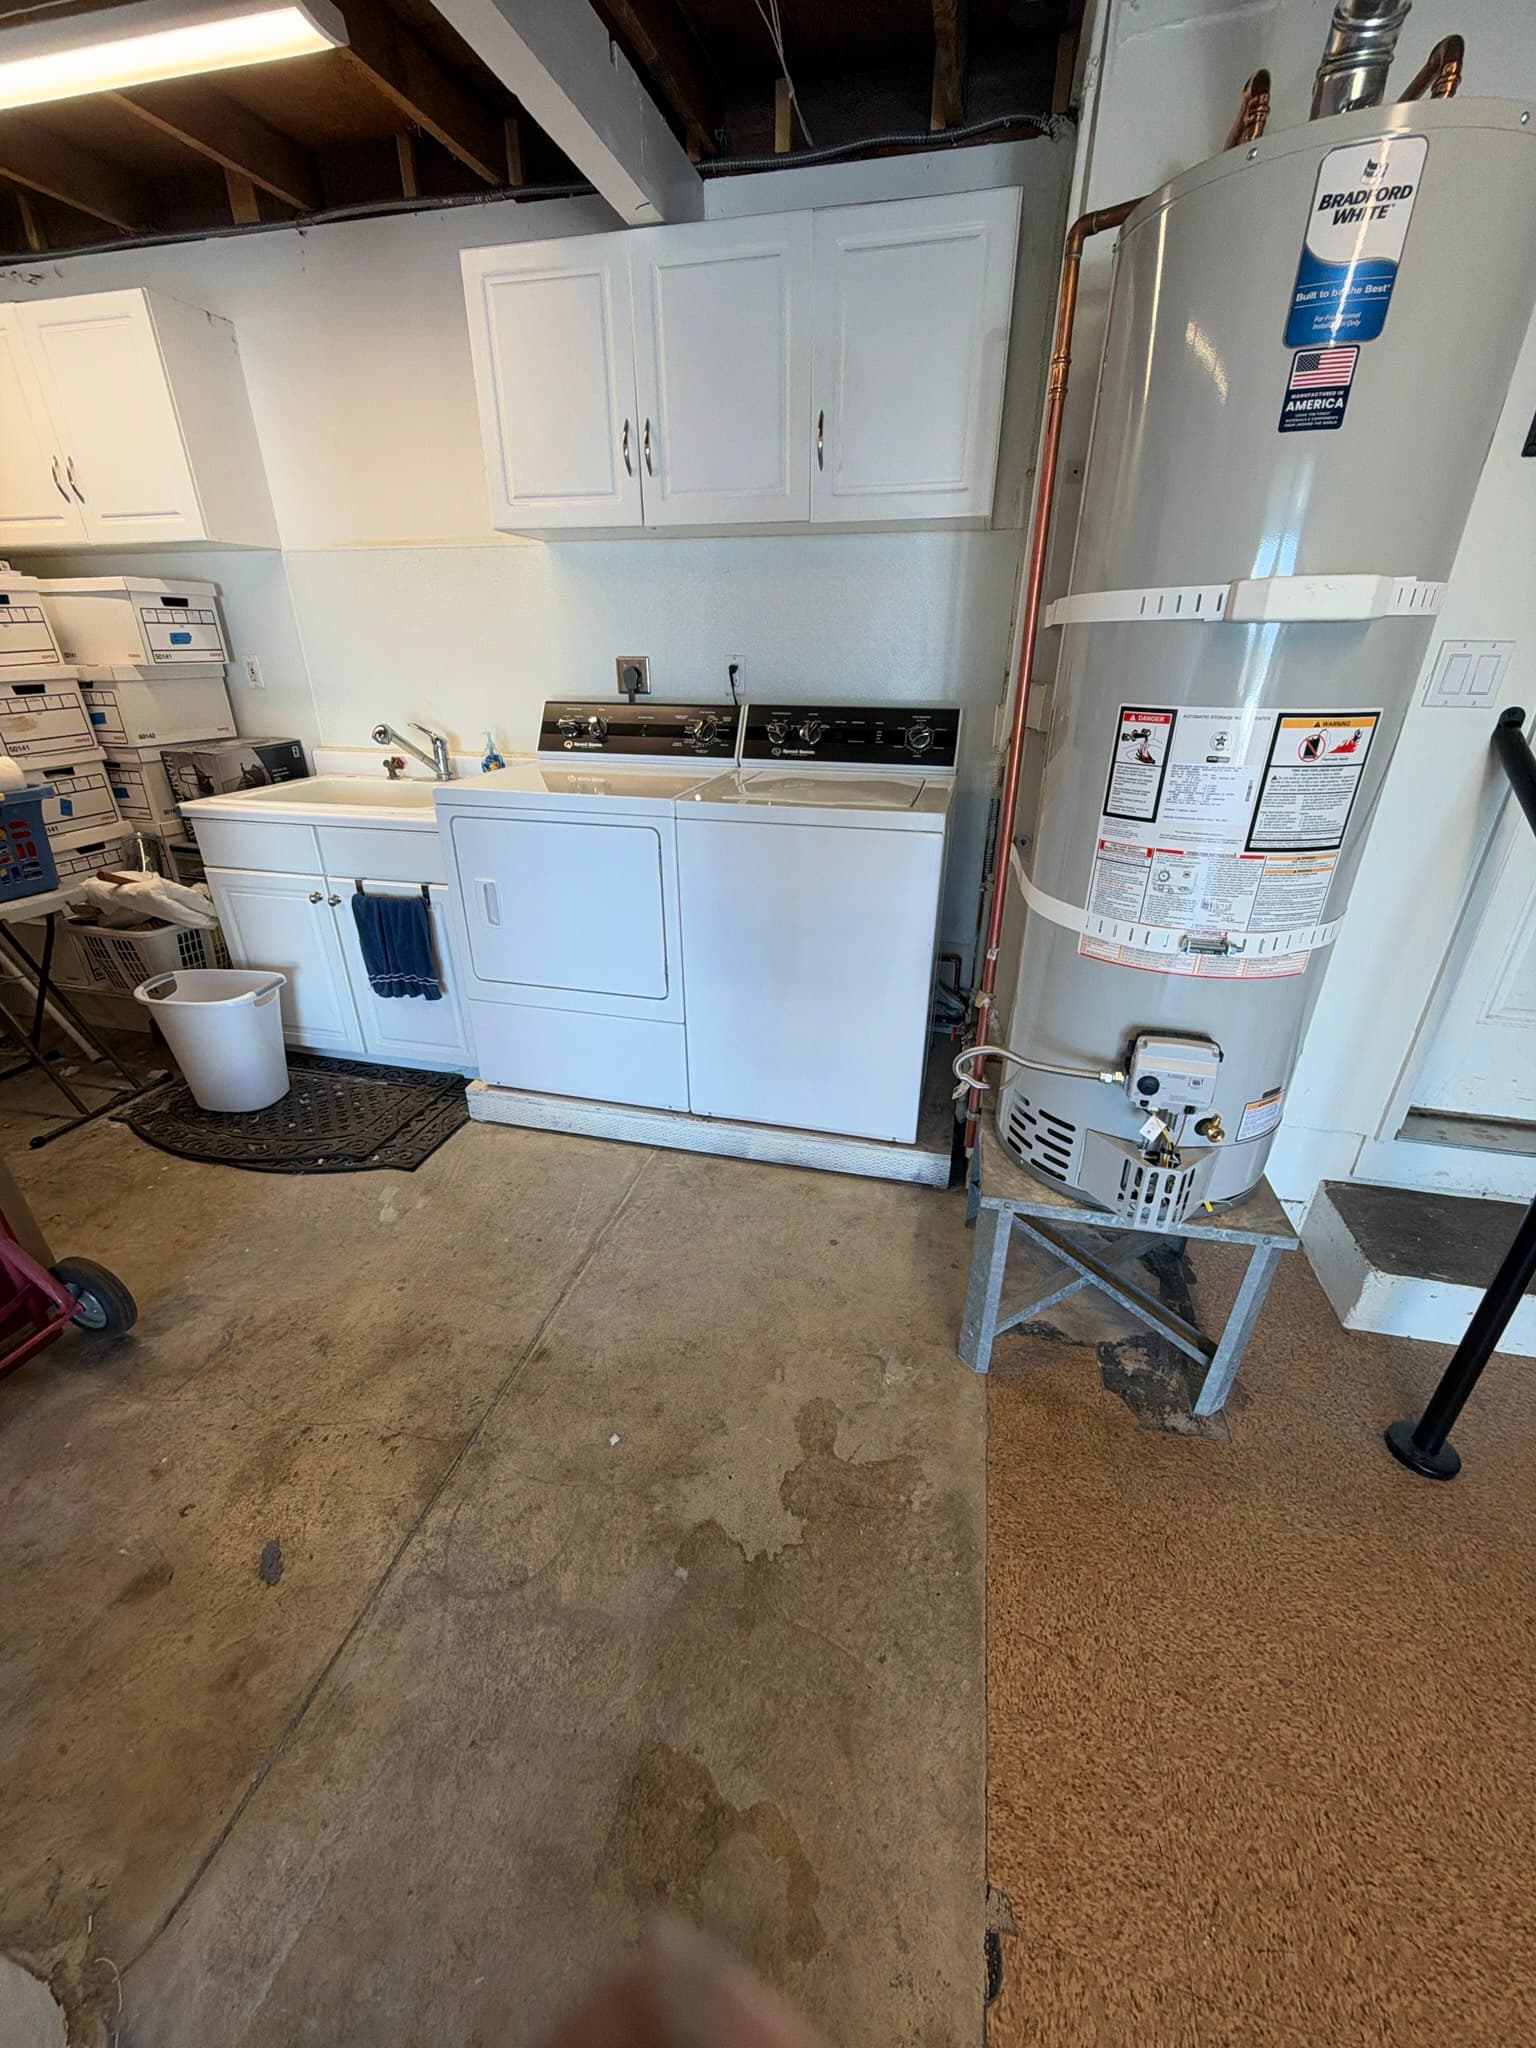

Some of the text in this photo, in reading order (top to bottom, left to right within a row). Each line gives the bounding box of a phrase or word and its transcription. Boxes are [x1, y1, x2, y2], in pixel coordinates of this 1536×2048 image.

[1317, 184, 1413, 211] BRADFORD
[1332, 203, 1390, 226] WHITE
[1295, 292, 1317, 302] Built
[1319, 290, 1329, 298] to
[1364, 284, 1388, 294] Best
[1291, 391, 1336, 399] MANUFACTURED
[1285, 397, 1344, 412] AMERICA
[1137, 714, 1165, 723] DANGER
[1322, 720, 1351, 728] WARNING
[9, 744, 30, 753] 50141
[47, 825, 58, 833] 141
